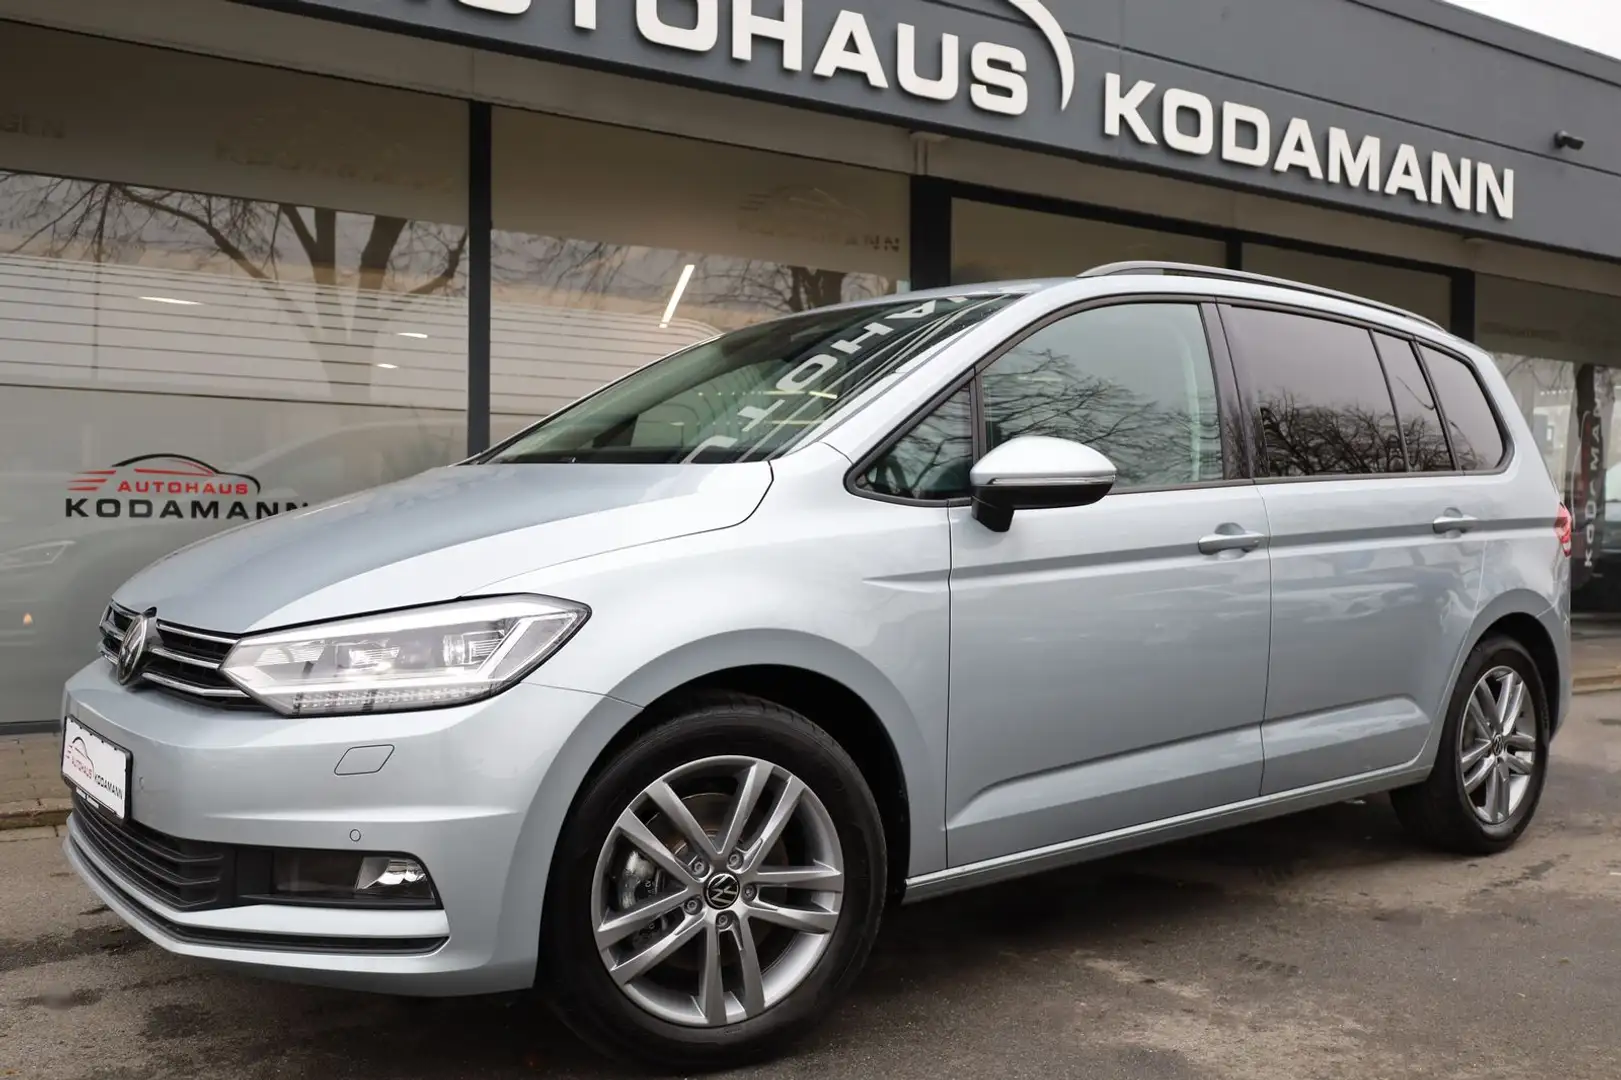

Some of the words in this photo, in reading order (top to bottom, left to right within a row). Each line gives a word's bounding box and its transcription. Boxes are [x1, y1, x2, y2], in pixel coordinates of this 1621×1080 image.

[1104, 72, 1514, 220] KODAMANN
[117, 480, 249, 495] AUTOHAUS
[65, 498, 309, 520] KODAMAN
[94, 772, 123, 801] KODAMANN
